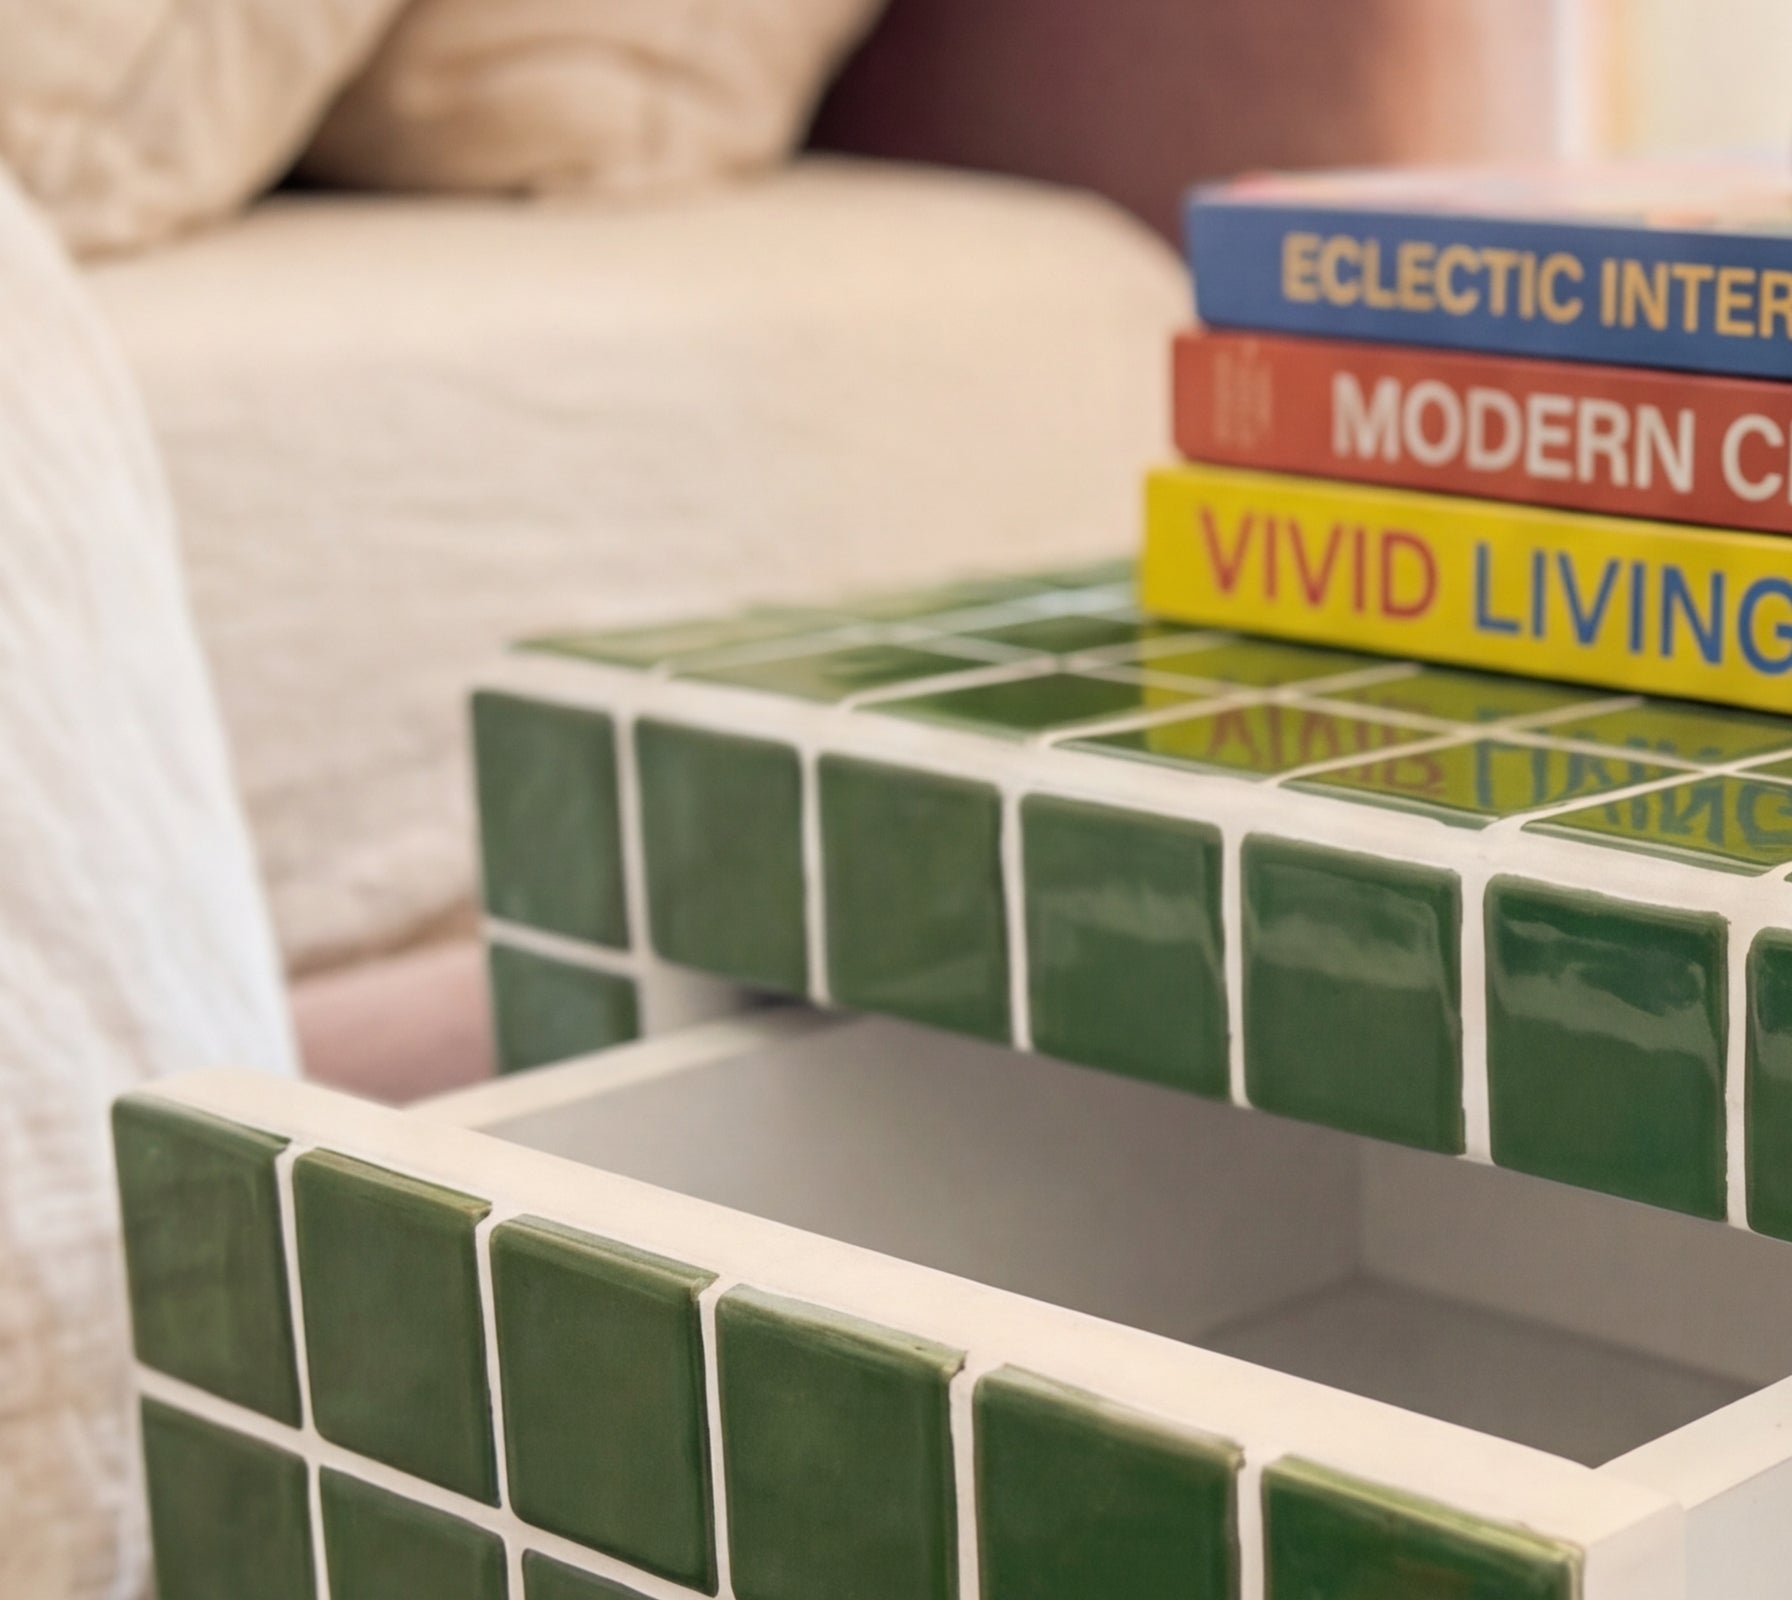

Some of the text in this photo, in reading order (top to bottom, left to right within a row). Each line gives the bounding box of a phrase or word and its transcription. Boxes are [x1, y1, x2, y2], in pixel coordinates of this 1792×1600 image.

[1282, 231, 1583, 324] ECLECTIC
[1332, 372, 1695, 493] MODERN
[1199, 507, 1438, 619] VIVID
